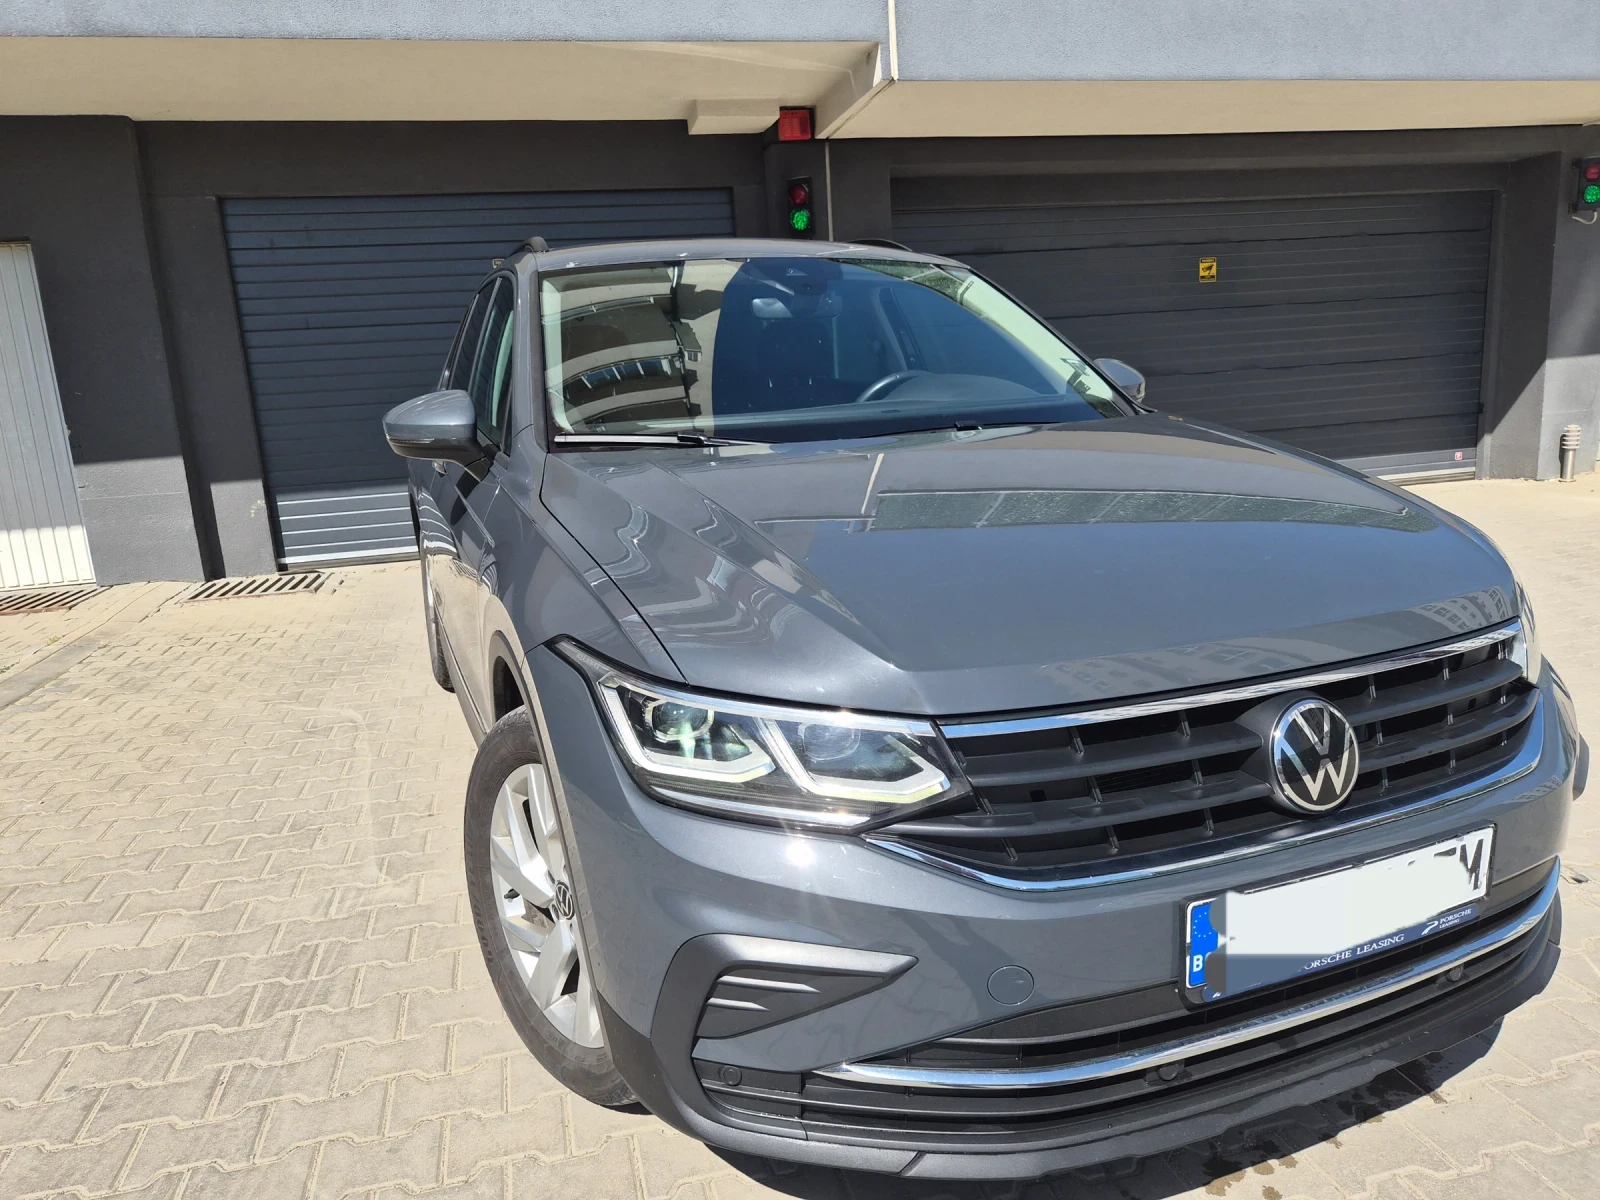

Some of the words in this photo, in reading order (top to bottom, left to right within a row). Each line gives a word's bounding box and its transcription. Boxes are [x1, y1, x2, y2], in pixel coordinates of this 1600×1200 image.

[1439, 908, 1472, 924] PORSCHE
[1302, 950, 1353, 971] ORSCHE
[1356, 934, 1405, 955] LEASING
